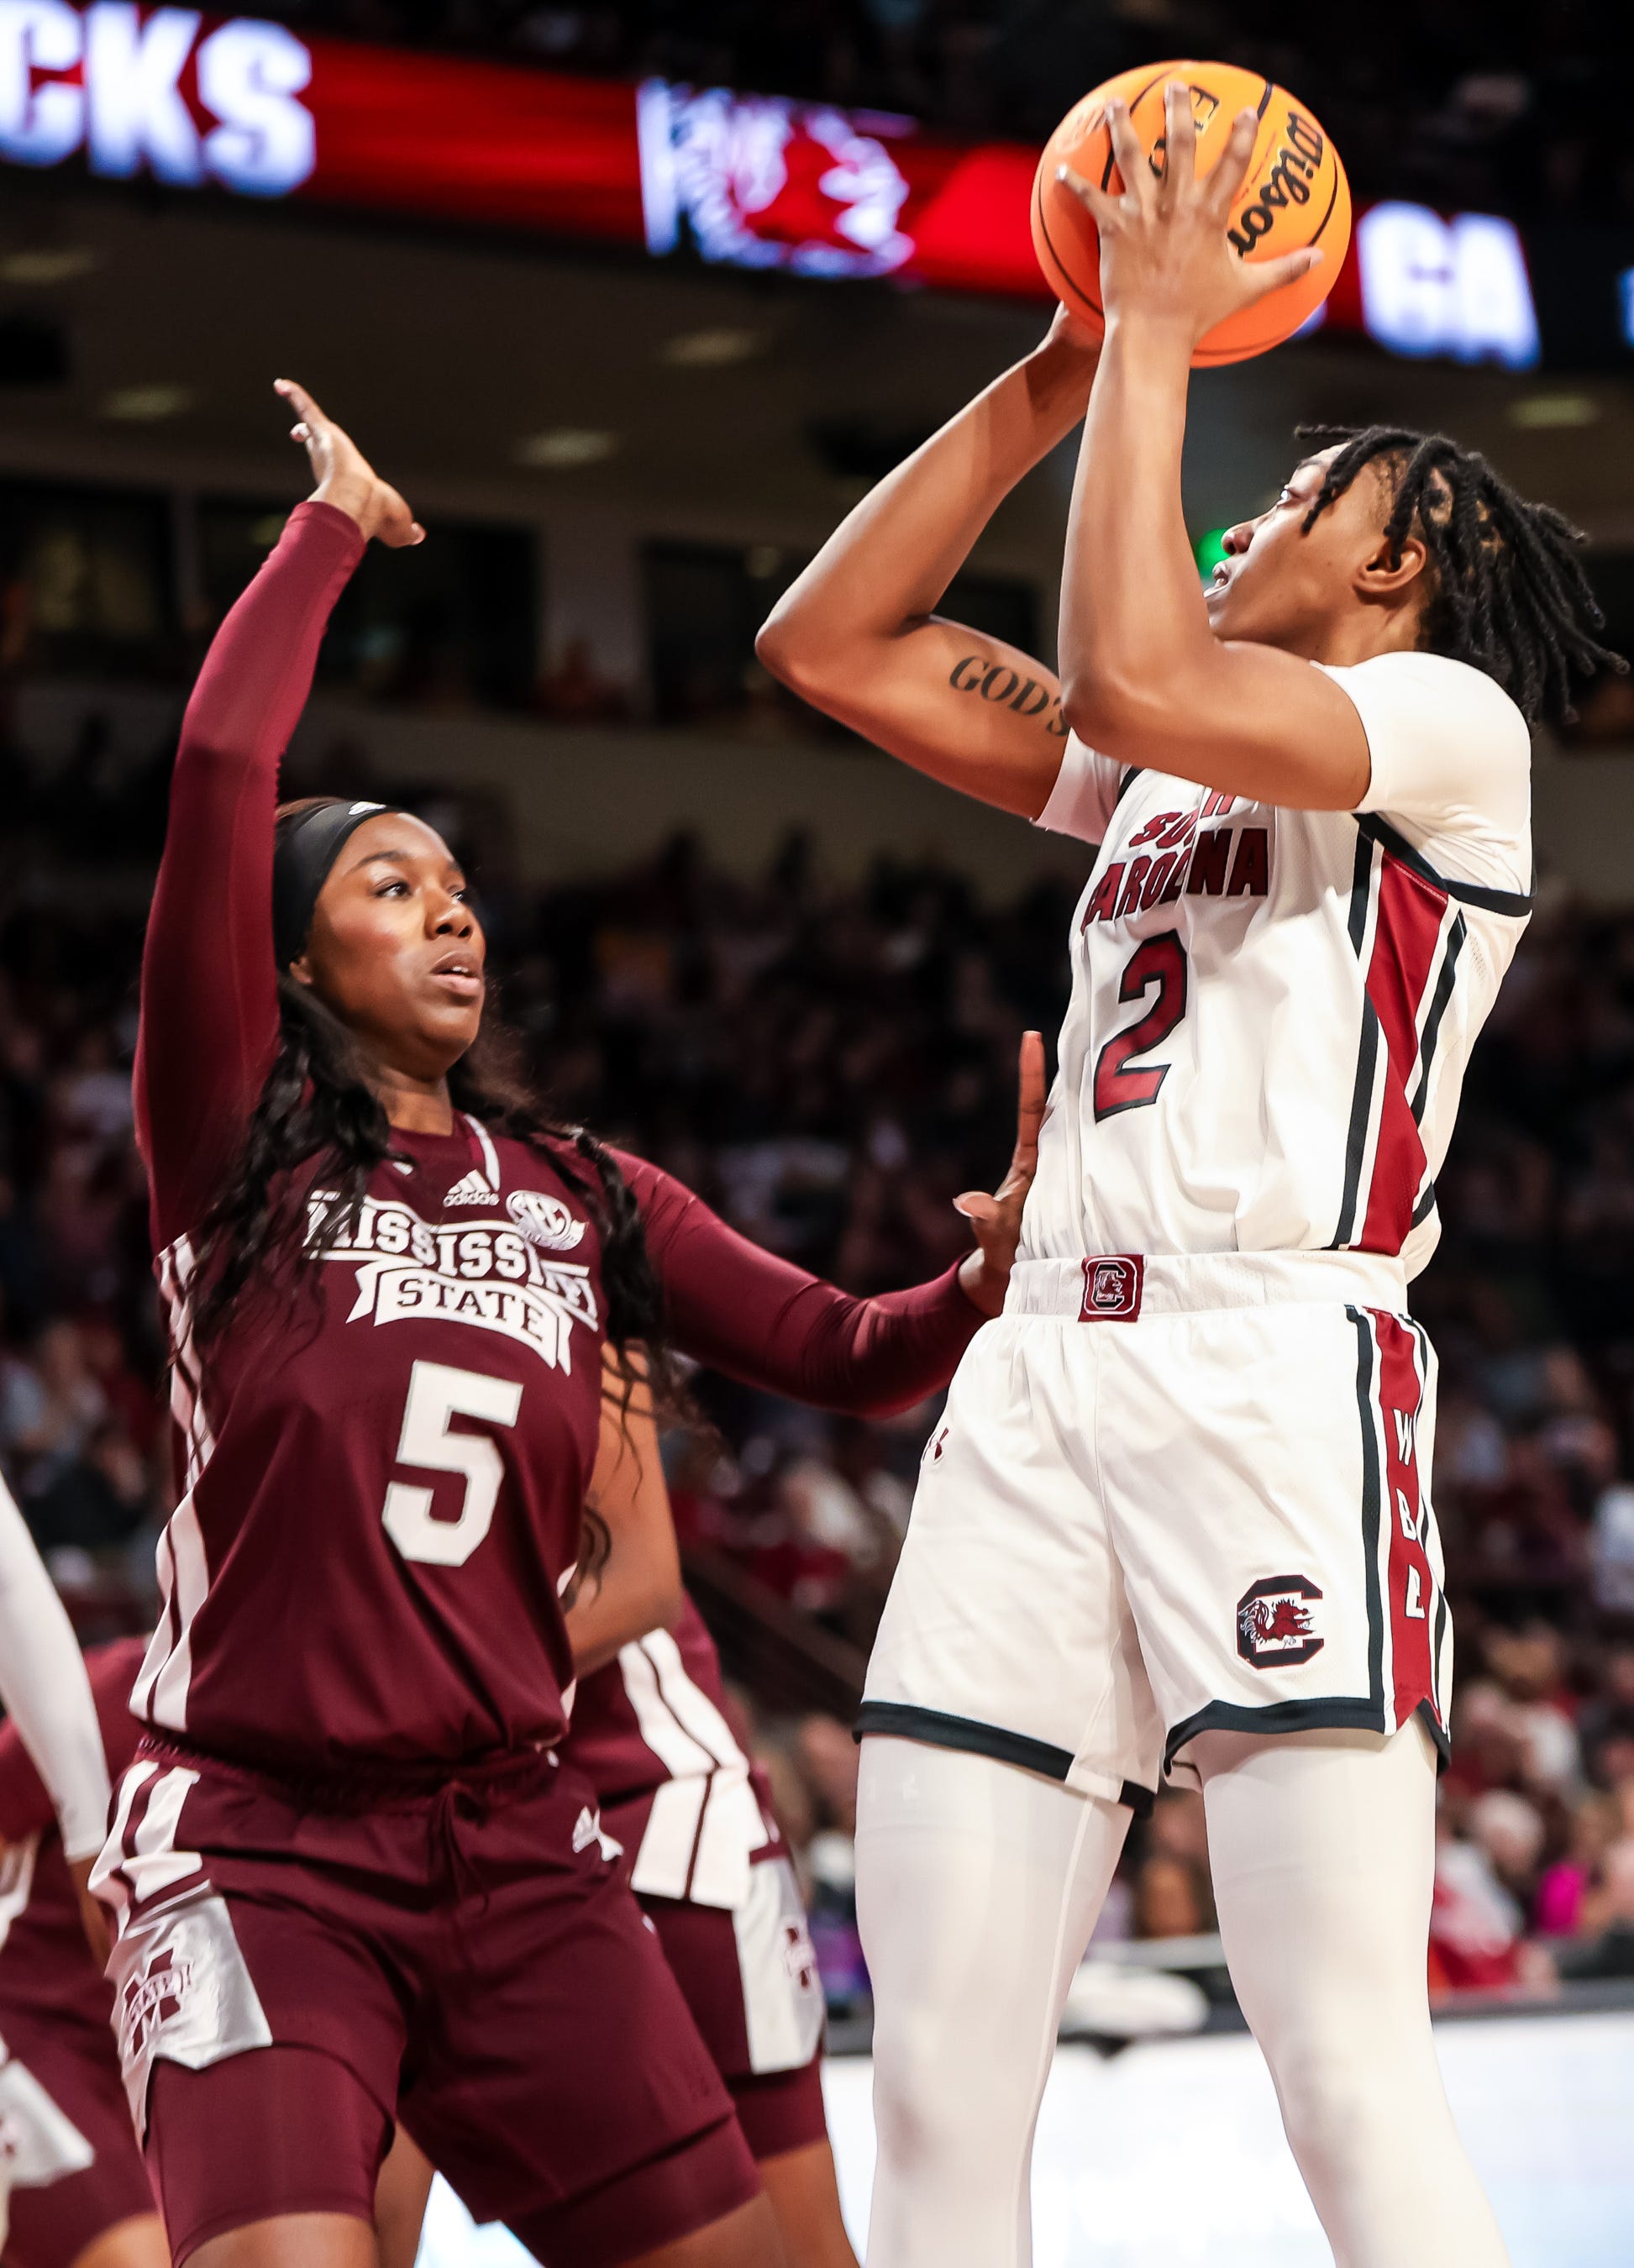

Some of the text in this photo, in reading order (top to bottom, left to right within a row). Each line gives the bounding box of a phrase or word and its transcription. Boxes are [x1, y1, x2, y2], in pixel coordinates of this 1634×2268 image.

[1227, 111, 1324, 257] Wilson
[1094, 928, 1188, 1123] 2
[443, 1190, 501, 1208] adidas
[397, 1277, 544, 1341] STATE
[381, 1359, 524, 1568] 5
